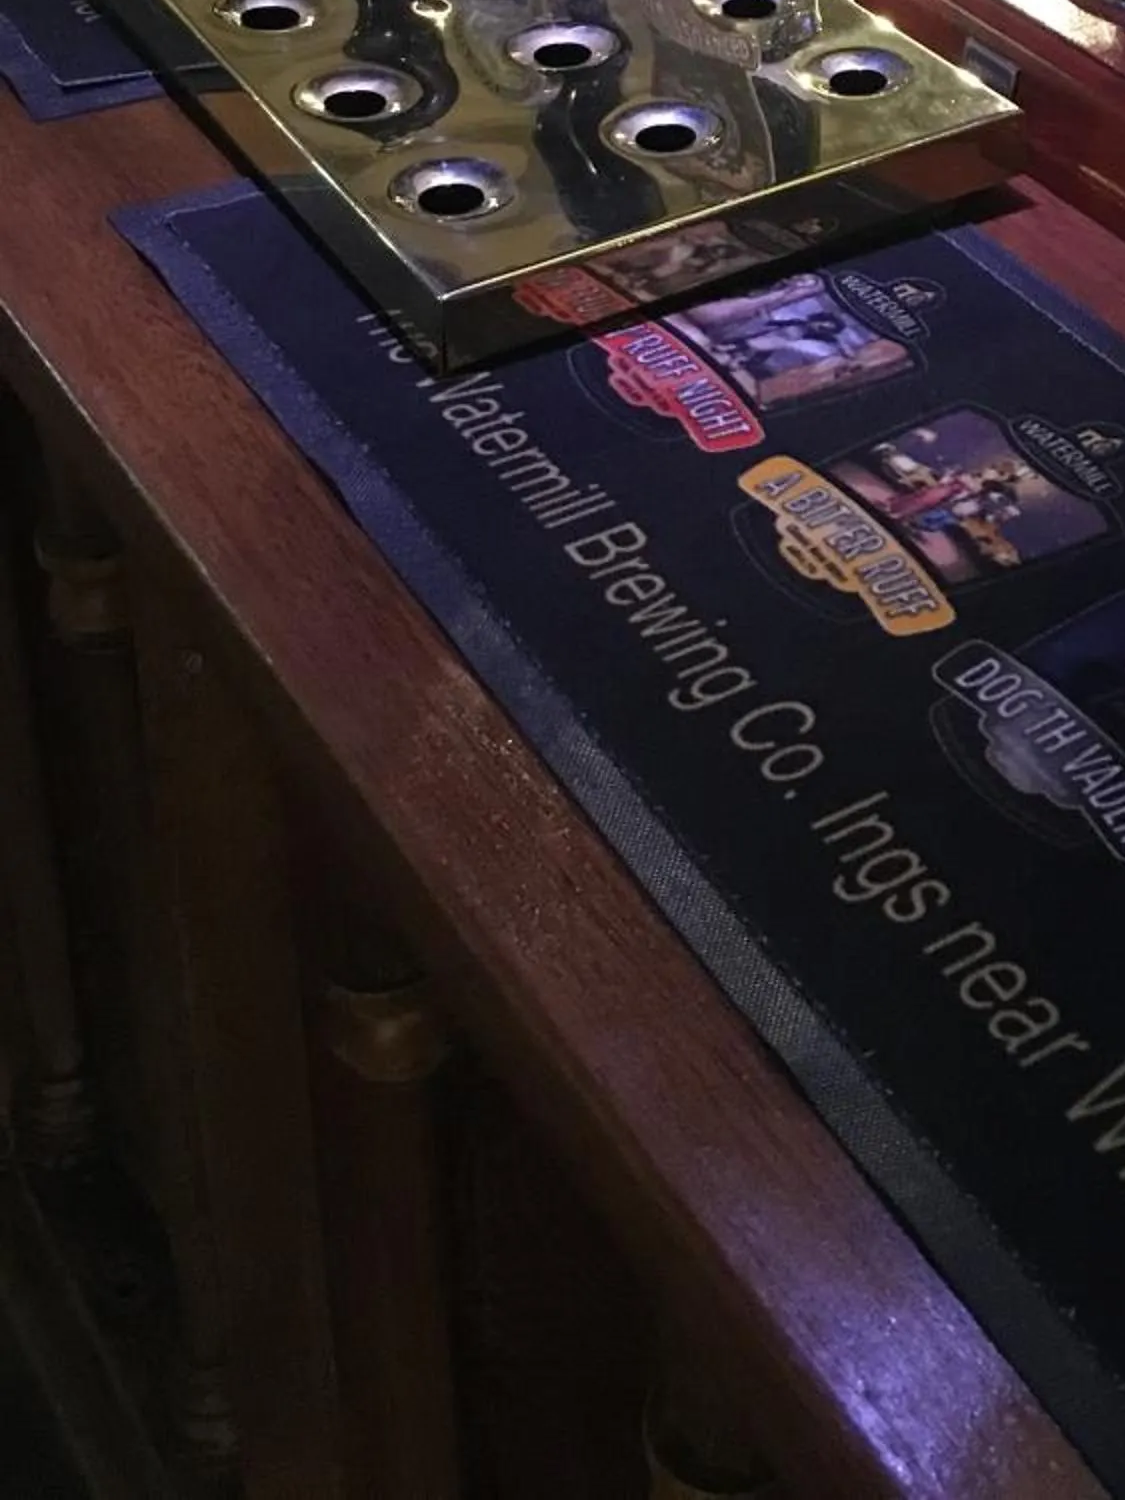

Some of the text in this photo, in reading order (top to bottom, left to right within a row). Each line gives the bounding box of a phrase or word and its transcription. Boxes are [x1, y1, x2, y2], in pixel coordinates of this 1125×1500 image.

[841, 275, 921, 338] WATERMILL
[622, 333, 699, 378] RUFF
[675, 377, 751, 440] NIGHT
[1019, 419, 1113, 493] WATERMILL
[753, 471, 803, 498] A
[856, 555, 939, 618] RUFF
[954, 656, 1044, 719] DOG
[1023, 707, 1089, 754] TH
[563, 520, 759, 712] Brewing
[729, 700, 826, 800] Co.
[810, 789, 952, 924] Ings
[922, 920, 1092, 1068] near
